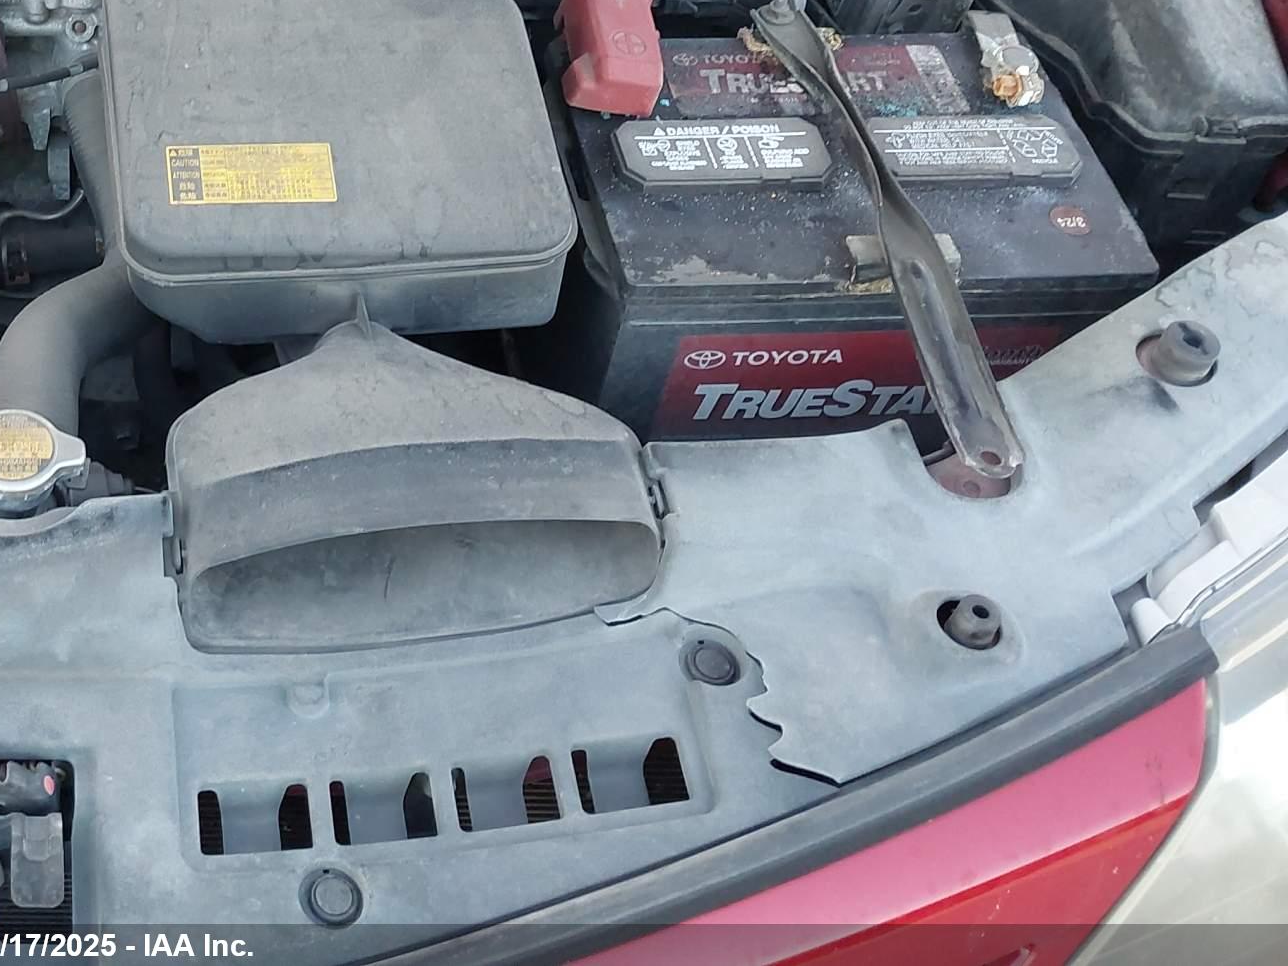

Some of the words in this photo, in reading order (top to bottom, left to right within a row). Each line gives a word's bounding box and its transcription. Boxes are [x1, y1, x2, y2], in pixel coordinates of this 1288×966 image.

[665, 126, 720, 136] DANGER
[731, 124, 780, 134] POISON
[171, 158, 200, 167] CAUTION
[172, 171, 201, 179] ATTENTION
[732, 349, 844, 367] TOYOTA
